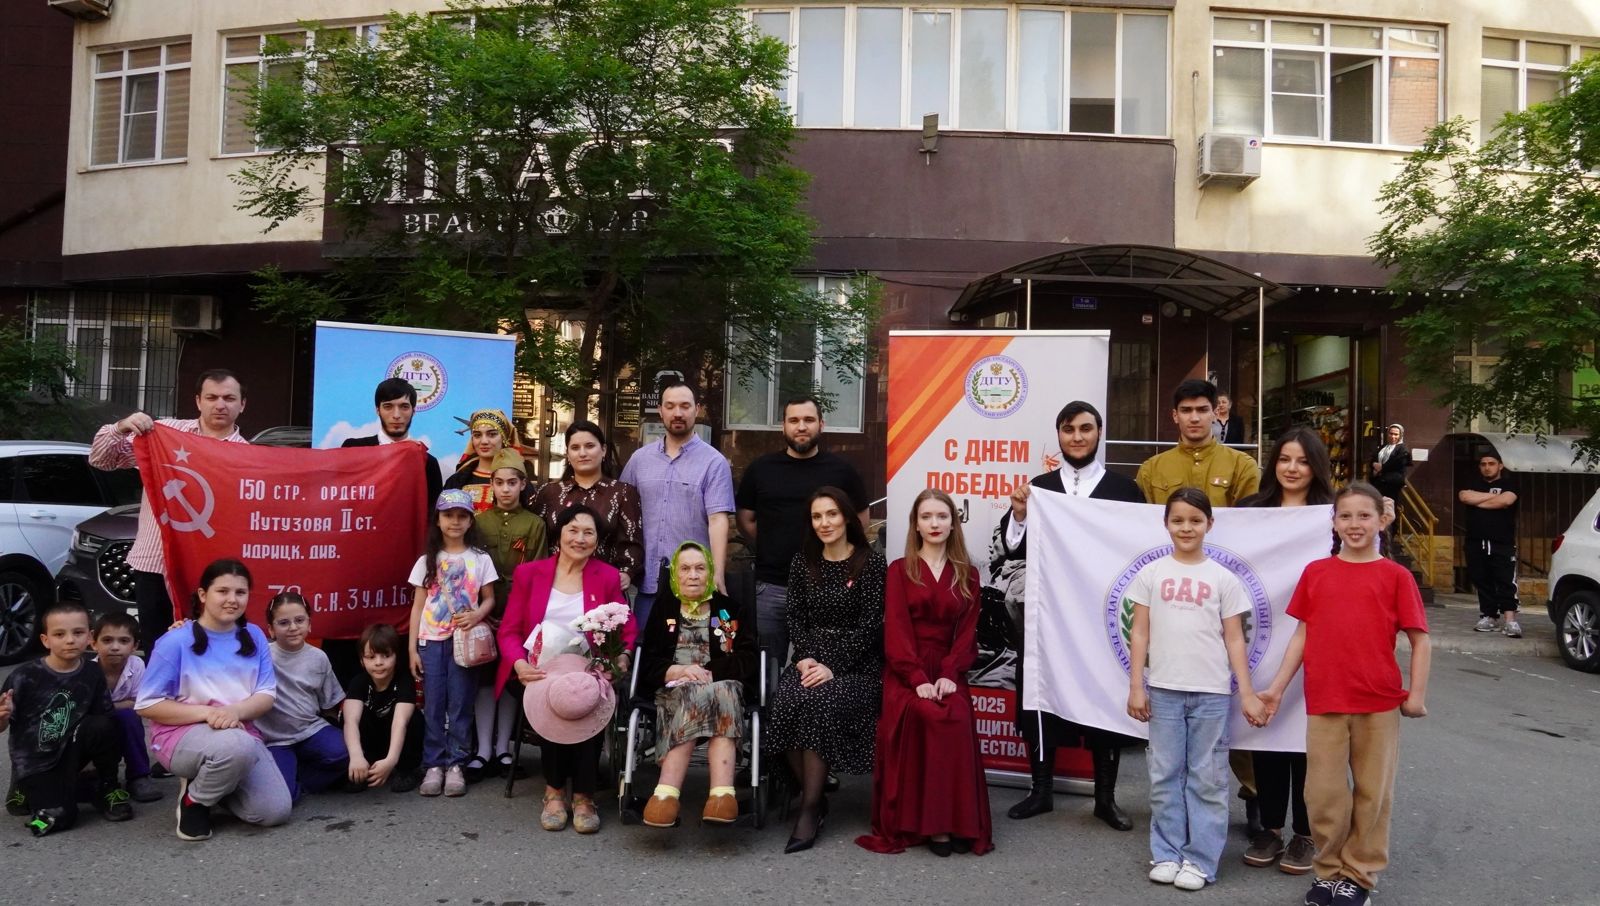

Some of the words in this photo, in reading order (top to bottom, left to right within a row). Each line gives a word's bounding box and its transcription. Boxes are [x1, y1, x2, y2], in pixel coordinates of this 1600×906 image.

[402, 371, 432, 381] ДГТУ
[980, 377, 1013, 386] ДГТУ
[944, 438, 958, 461] С
[965, 440, 1030, 465] ДНЕМ
[239, 479, 266, 500] 150
[320, 485, 375, 500] ОРДЕНА
[1160, 577, 1212, 608] GAP
[1203, 548, 1271, 629] УДАРСТВЕННЫЙ
[971, 695, 1006, 714] 2025
[978, 739, 1027, 758] ЕСТВА
